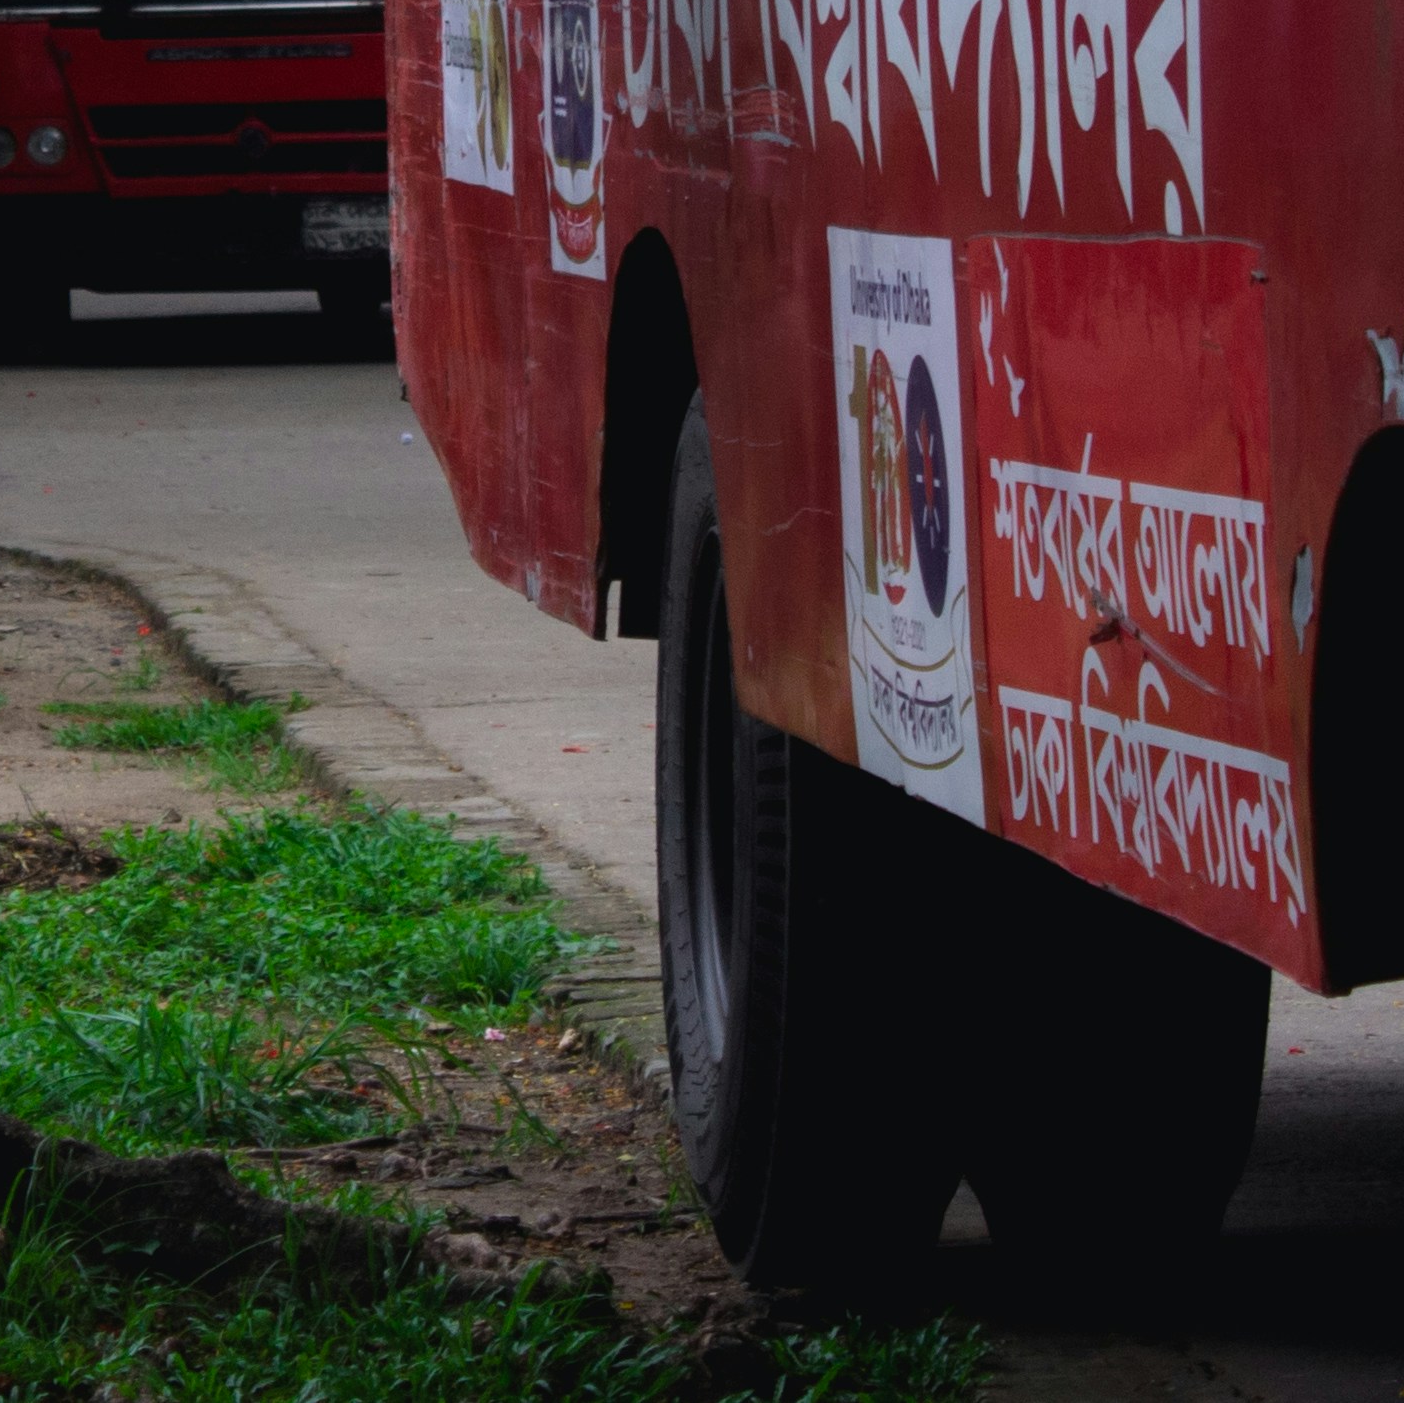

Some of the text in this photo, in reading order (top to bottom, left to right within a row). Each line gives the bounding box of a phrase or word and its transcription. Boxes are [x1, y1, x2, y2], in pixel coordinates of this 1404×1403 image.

[850, 265, 890, 335] University
[902, 271, 931, 327] Dhaka
[1130, 481, 1271, 672] আলোয়
[999, 645, 1306, 929] ঢাকা বিশ্ববিদ্যালয়
